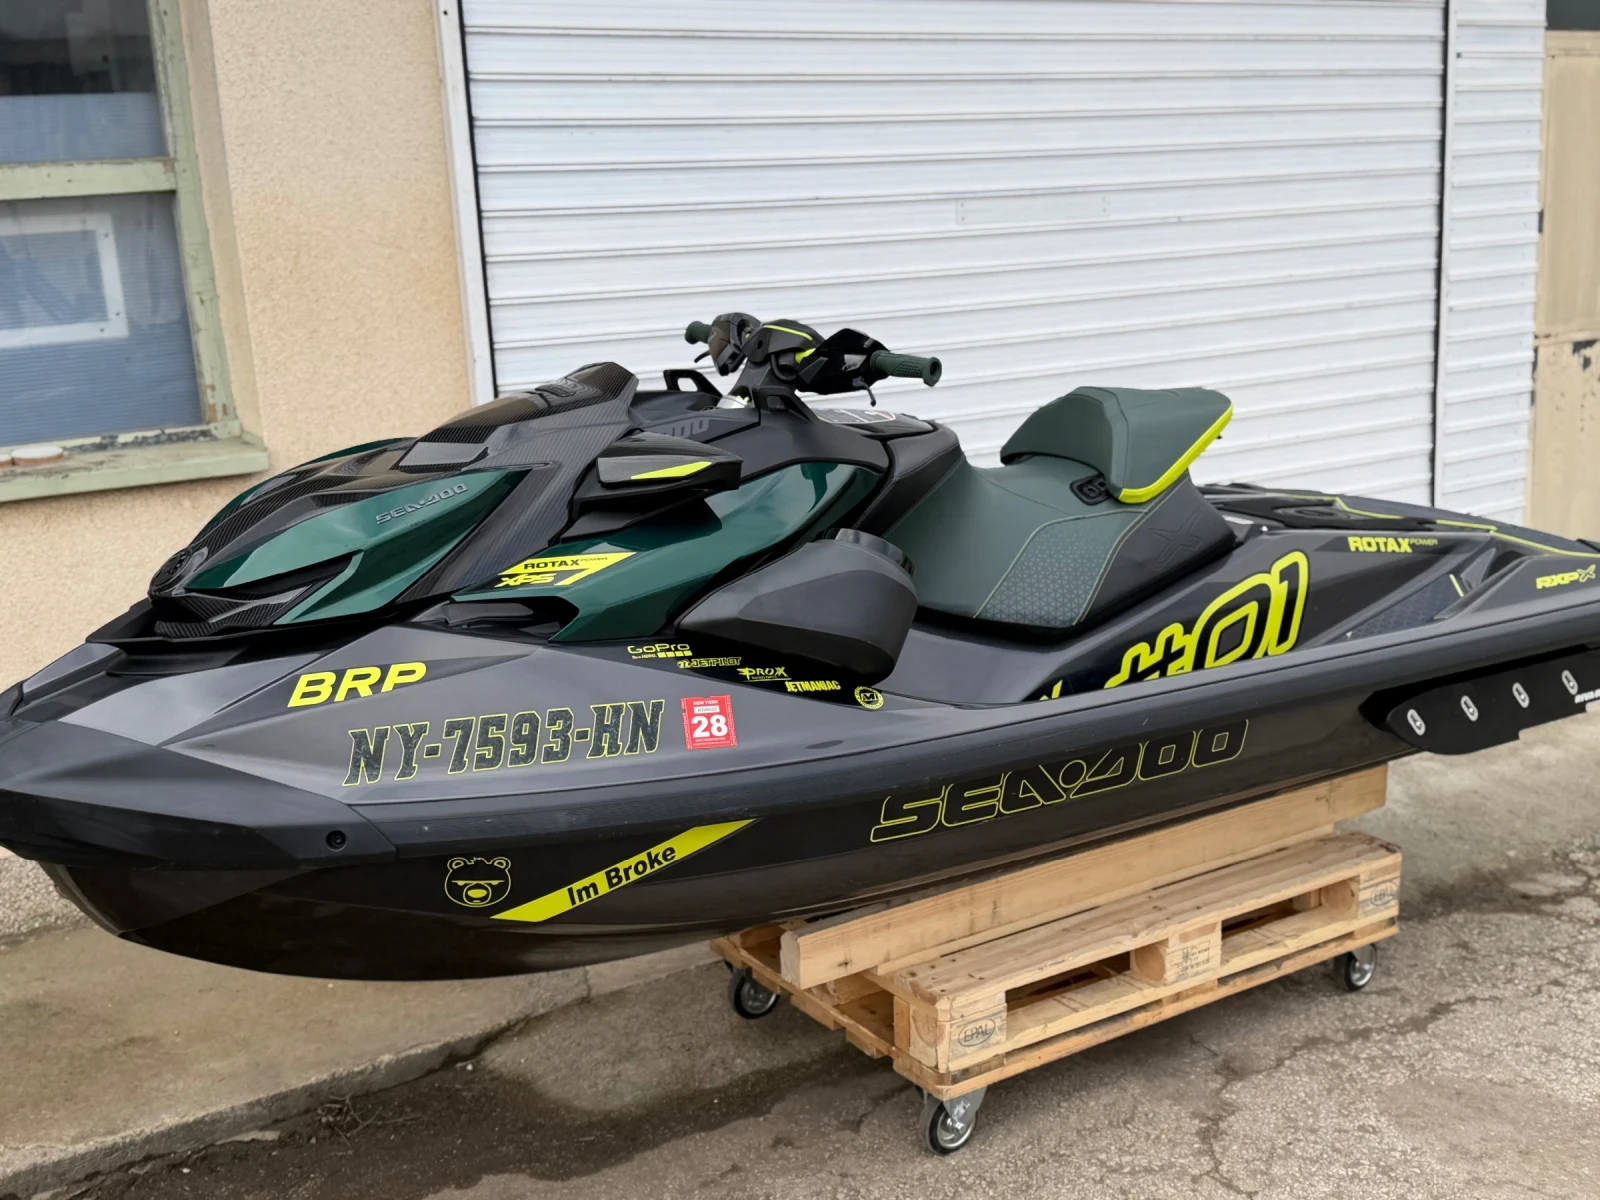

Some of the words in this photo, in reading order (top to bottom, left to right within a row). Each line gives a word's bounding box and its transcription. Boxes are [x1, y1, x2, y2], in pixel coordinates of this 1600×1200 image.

[1347, 536, 1412, 553] ROTAX
[1410, 538, 1438, 546] POWER
[524, 559, 580, 570] ROTAX
[494, 572, 558, 588] XPS
[627, 643, 691, 654] GoPro
[690, 657, 742, 667] JETPILOT
[287, 661, 427, 708] BRP
[785, 680, 841, 693] JETMANIAC
[691, 714, 728, 738] 28
[341, 698, 665, 787] NY-7593-HN
[567, 884, 600, 907] Im
[604, 843, 678, 892] Broke
[963, 1023, 991, 1042] EPAL
